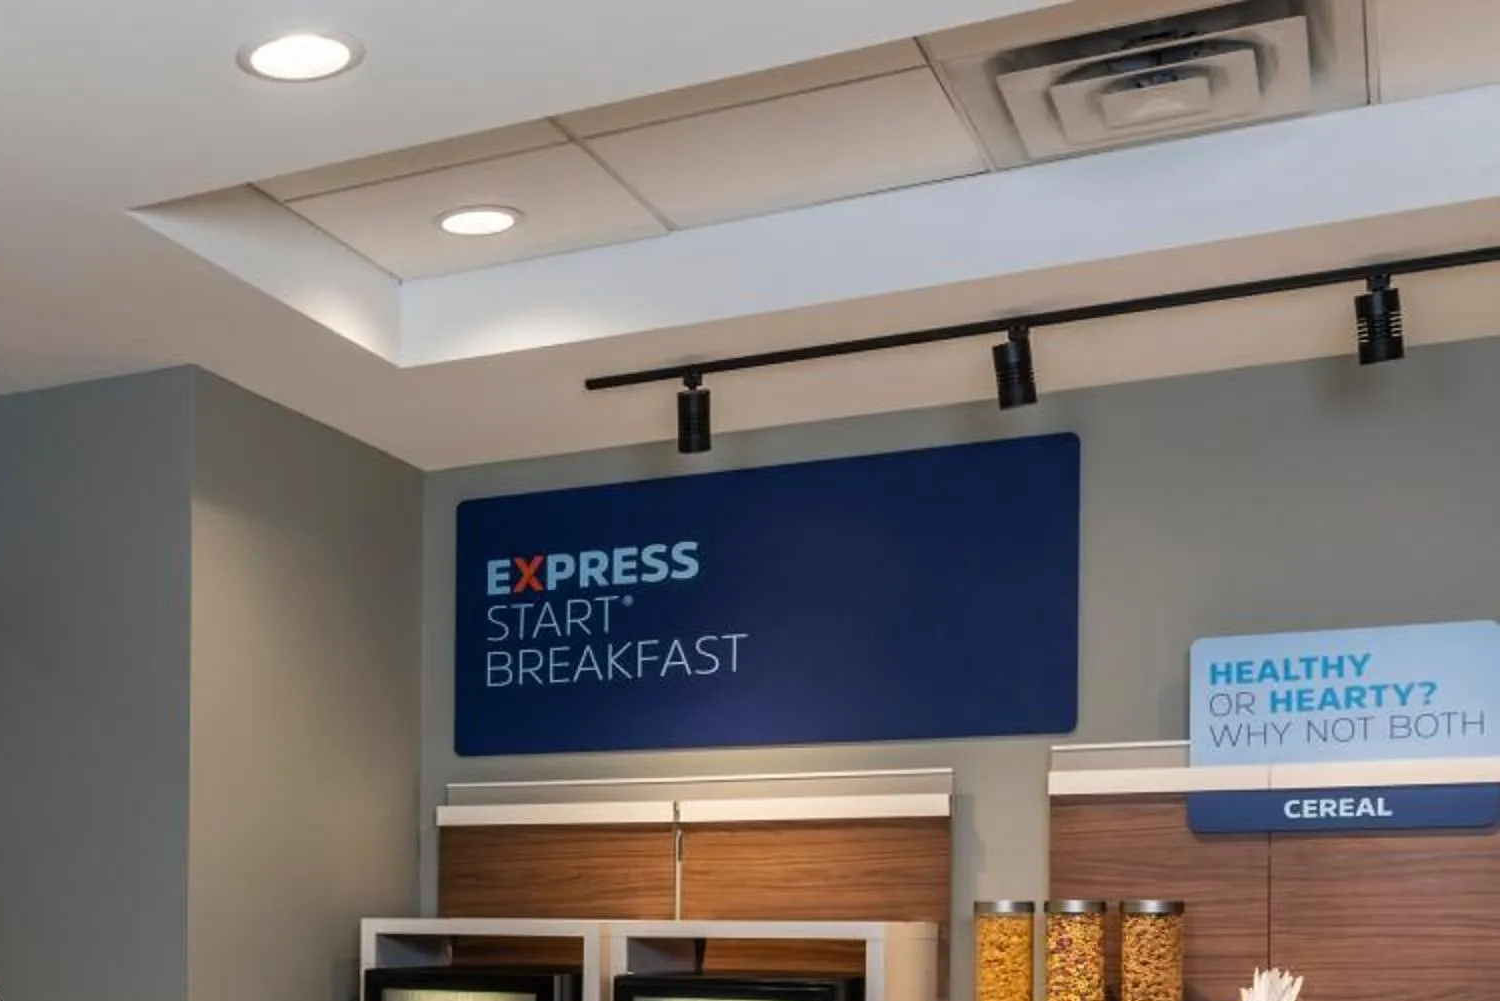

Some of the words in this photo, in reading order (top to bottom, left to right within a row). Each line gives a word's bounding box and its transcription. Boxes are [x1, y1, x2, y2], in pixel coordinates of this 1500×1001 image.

[486, 541, 699, 595] EXPRESS
[486, 633, 748, 687] BREAKFAST
[1209, 653, 1372, 685] HEALTHY
[1209, 691, 1255, 717] OR
[1269, 682, 1437, 714] HEARTY?
[1209, 721, 1292, 748] WHY
[1306, 716, 1376, 745] NOT
[1389, 710, 1485, 740] BOTH
[1284, 797, 1392, 819] CEREAL
